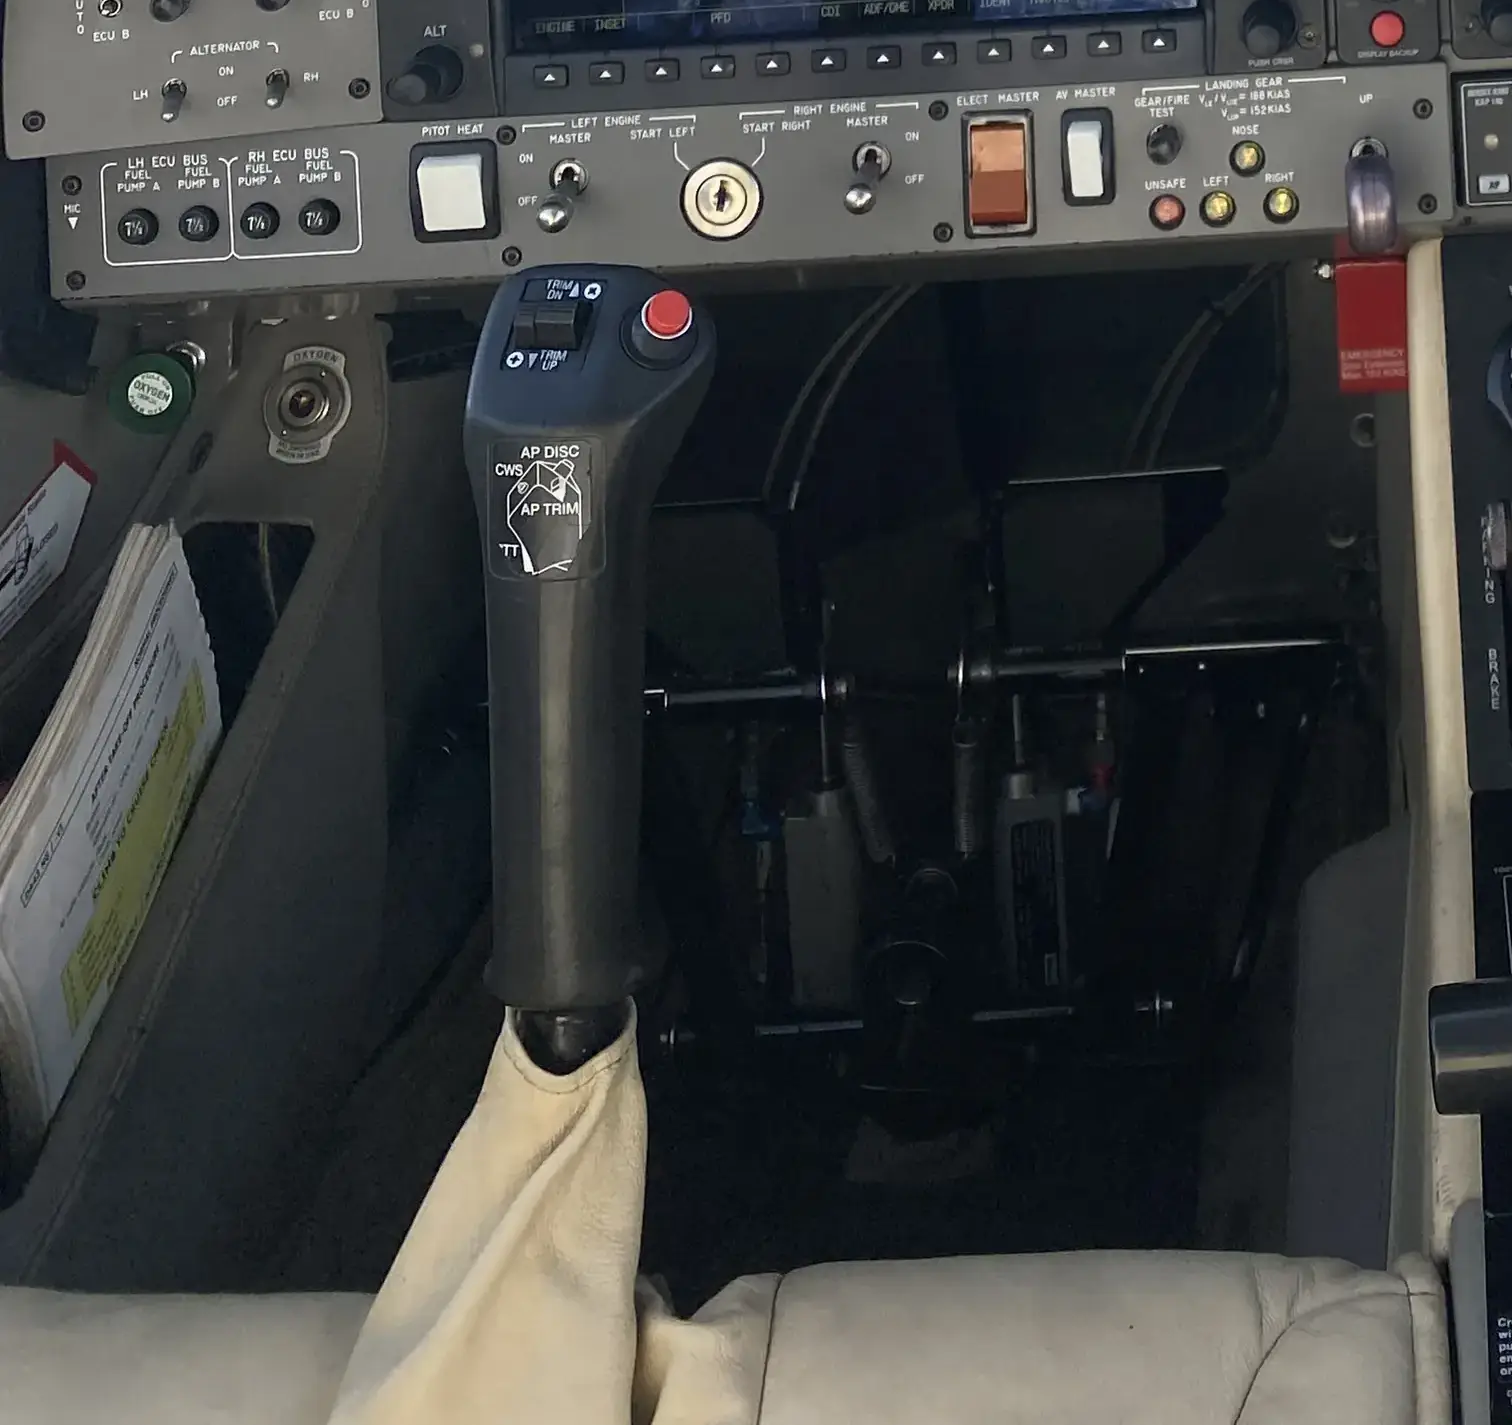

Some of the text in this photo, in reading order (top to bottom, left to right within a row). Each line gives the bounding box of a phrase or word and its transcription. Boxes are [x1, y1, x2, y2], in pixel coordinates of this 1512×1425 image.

[424, 25, 446, 38] ALT
[189, 40, 260, 55] ALTERNATOR
[1205, 76, 1283, 91] LANDING GEAR
[957, 91, 1040, 107] ELECT MASTER
[794, 101, 866, 116] RIGHT ENGINE
[571, 114, 641, 129] LEFT ENGINE
[422, 123, 483, 137] PITOT HEAT
[1232, 124, 1259, 136] NOSE
[550, 132, 591, 144] MASTER
[1145, 177, 1186, 190] UNSAFE
[1203, 175, 1229, 187] LEFT
[1265, 172, 1294, 184] RIGHT
[293, 350, 339, 363] OXYGEN
[133, 381, 171, 403] OXYGEN
[521, 445, 580, 458] AP DISC
[495, 464, 523, 476] CWS
[521, 502, 579, 516] AP TRIM
